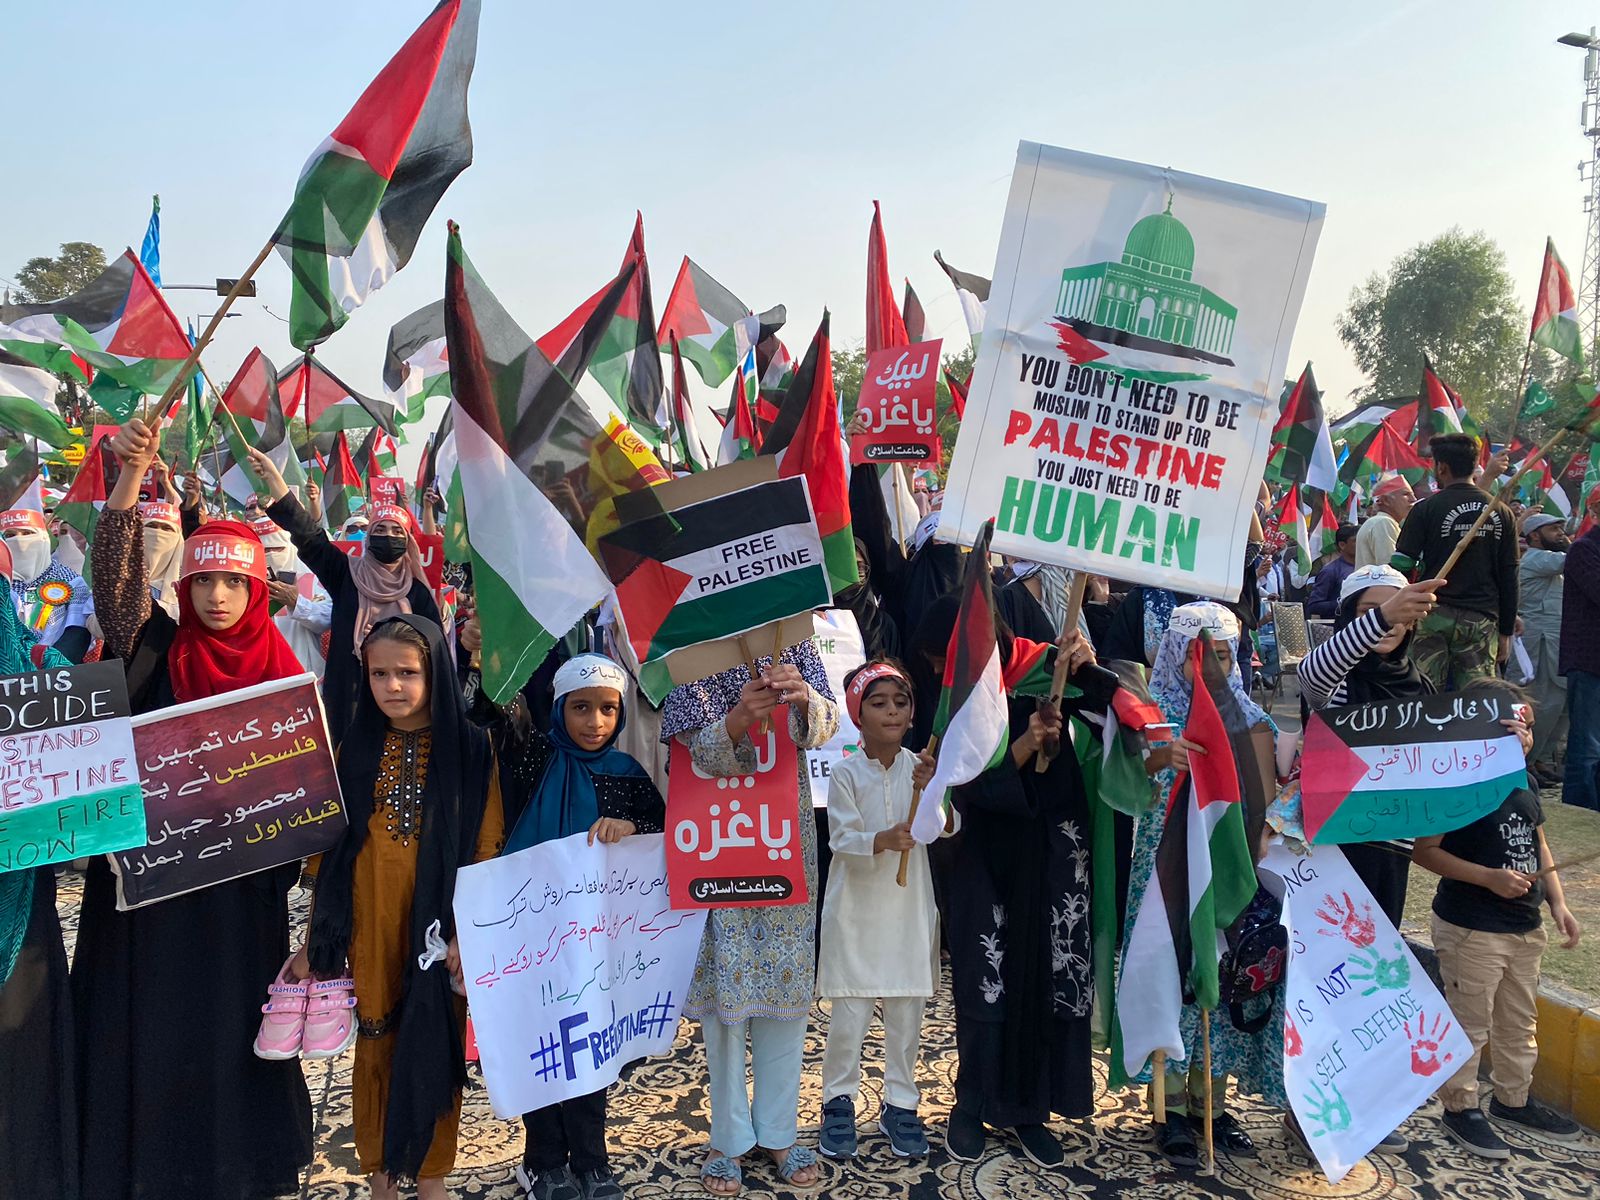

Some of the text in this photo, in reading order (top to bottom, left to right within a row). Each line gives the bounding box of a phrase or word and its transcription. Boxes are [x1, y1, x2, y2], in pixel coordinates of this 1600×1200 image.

[1020, 353, 1241, 430] YOU DON'T NEED TO BE
[1033, 391, 1211, 449] MUSLIM TO STAND UP FOR
[1003, 410, 1226, 491] PALESTINE
[1037, 459, 1182, 509] YOU JUST NEED TO BE
[1457, 501, 1482, 514] RELIEF
[721, 534, 777, 564] FREE
[996, 475, 1200, 573] HUMAN
[697, 548, 812, 593] PALESTINE
[0, 725, 101, 765] STAND
[0, 757, 129, 812] ESTINE
[57, 795, 132, 832] FIRE
[734, 878, 786, 898] جماعت
[315, 979, 355, 990] FASHION
[1295, 962, 1353, 1028] IS NOT
[1315, 988, 1424, 1087] SELF DEFENSE
